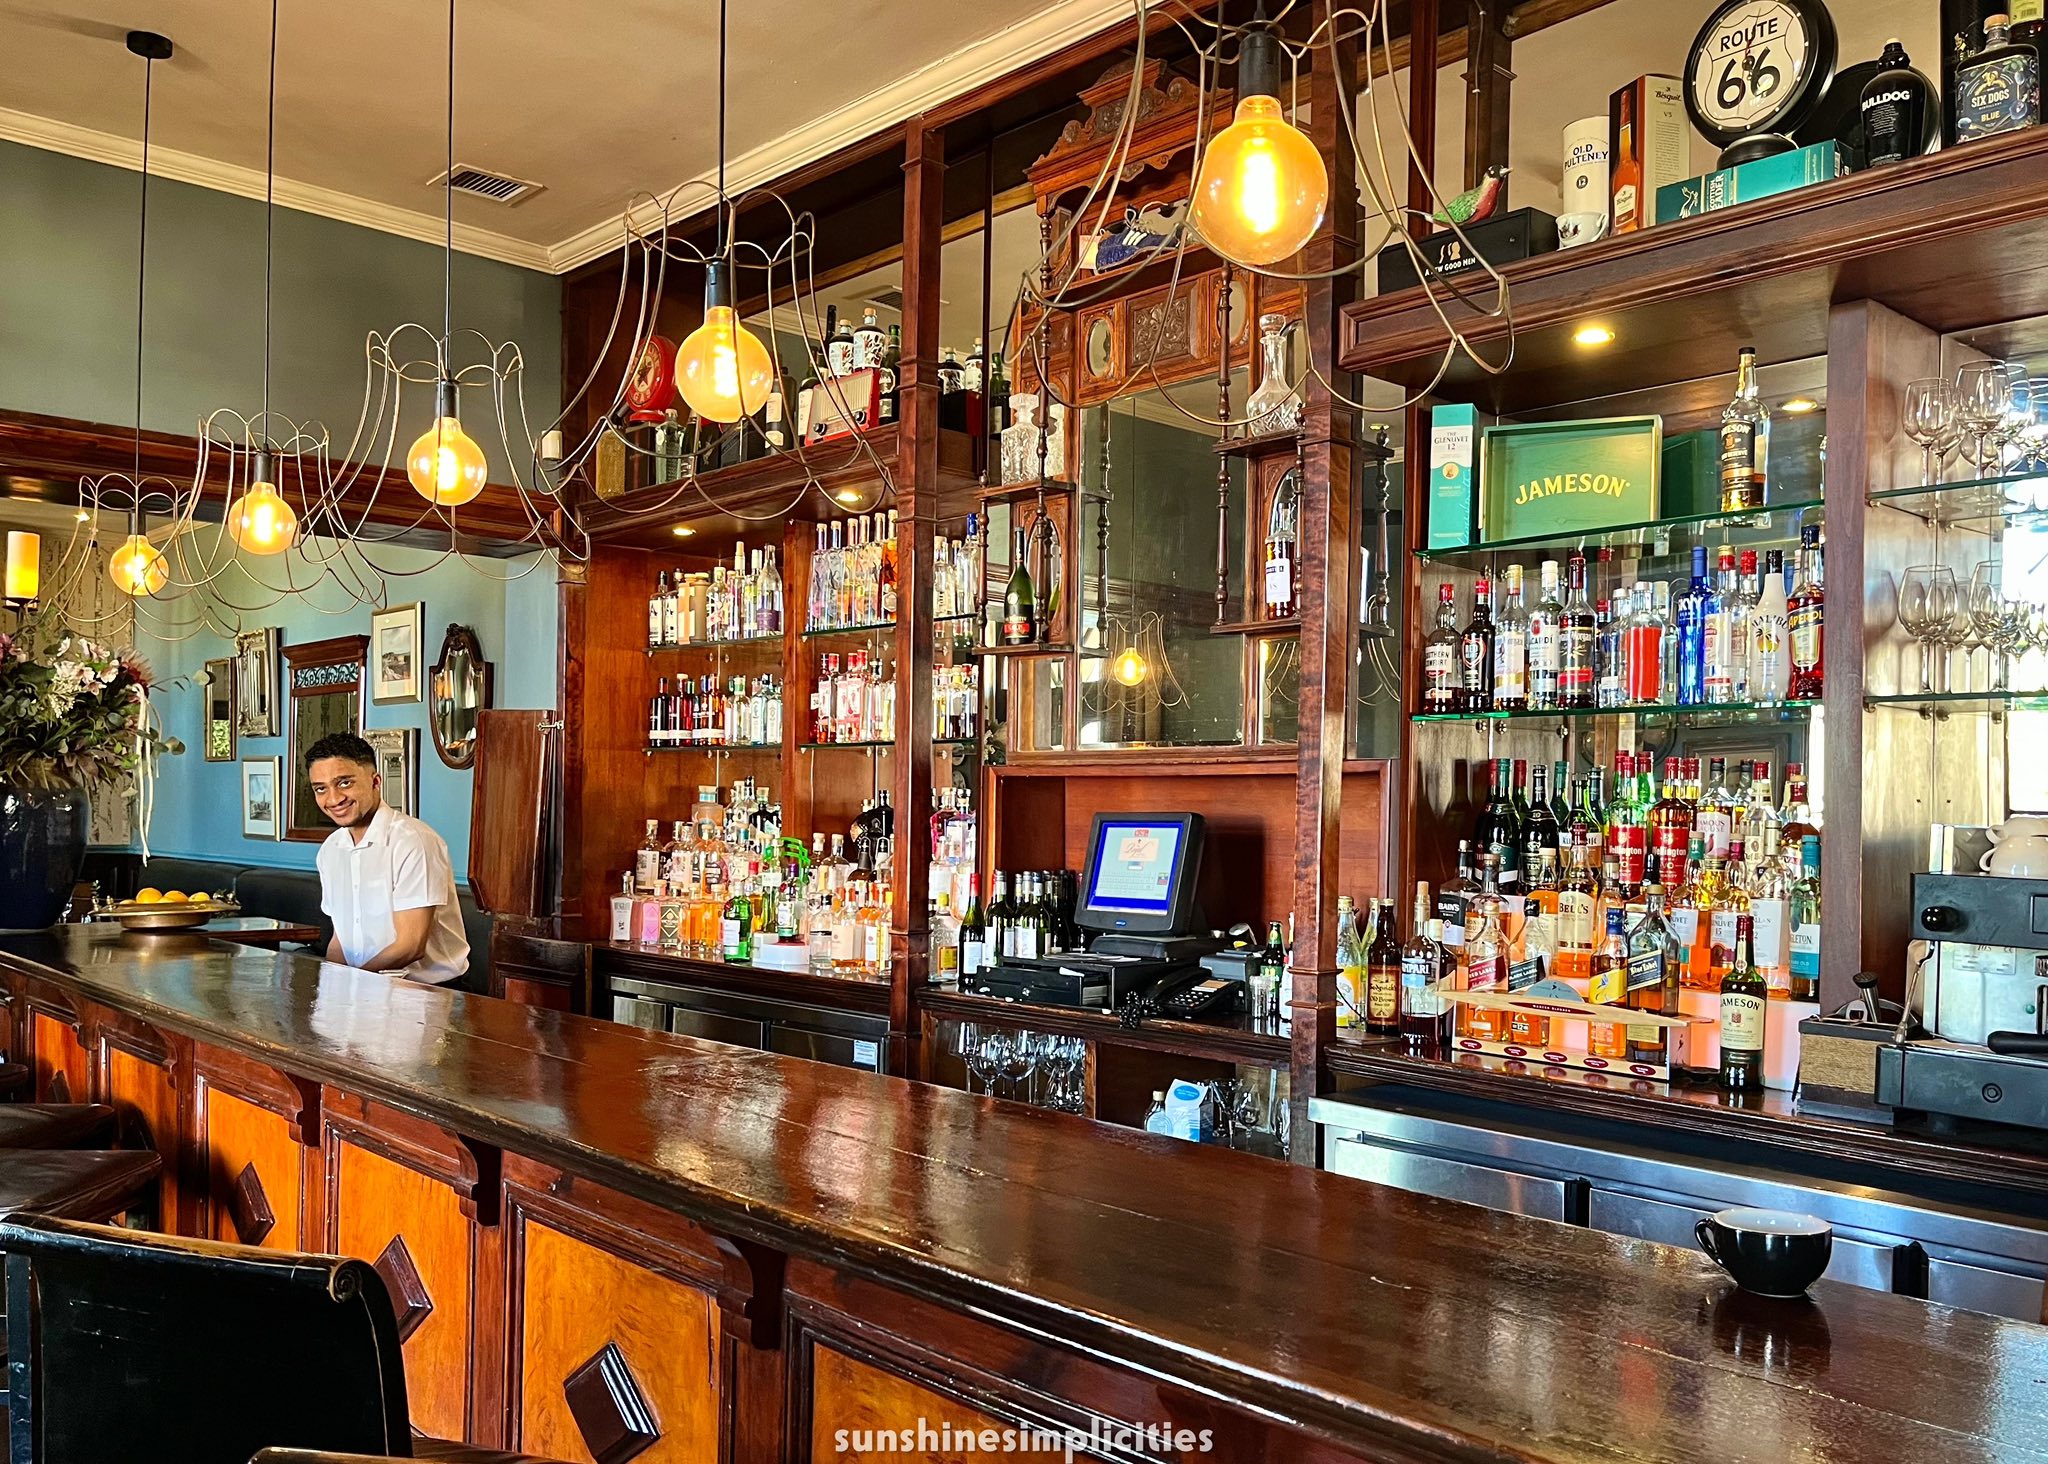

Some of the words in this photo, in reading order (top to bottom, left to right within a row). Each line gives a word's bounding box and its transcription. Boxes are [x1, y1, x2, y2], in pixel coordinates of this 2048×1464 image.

[1720, 17, 1778, 52] ROUTE
[1717, 46, 1781, 109] 66
[1861, 90, 1911, 112] BULLDOG
[1971, 94, 1988, 109] SIX
[1988, 89, 2010, 105] DOGS
[1981, 111, 2001, 122] BLUE
[1573, 144, 1593, 156] OLD
[1564, 151, 1609, 170] PULTENEY
[1714, 173, 1724, 209] EADER
[1444, 260, 1461, 271] GOOD
[1463, 257, 1476, 266] MEN
[1434, 436, 1468, 445] GLENLIVET
[1447, 443, 1456, 451] 12
[1515, 473, 1626, 505] JAMESON
[1789, 610, 1823, 629] APEROL
[1700, 825, 1724, 833] ROUSE
[1438, 902, 1460, 912] BAIN'S
[1559, 903, 1589, 914] BELL'S
[1791, 934, 1812, 944] LETON
[1402, 963, 1430, 973] MPARI
